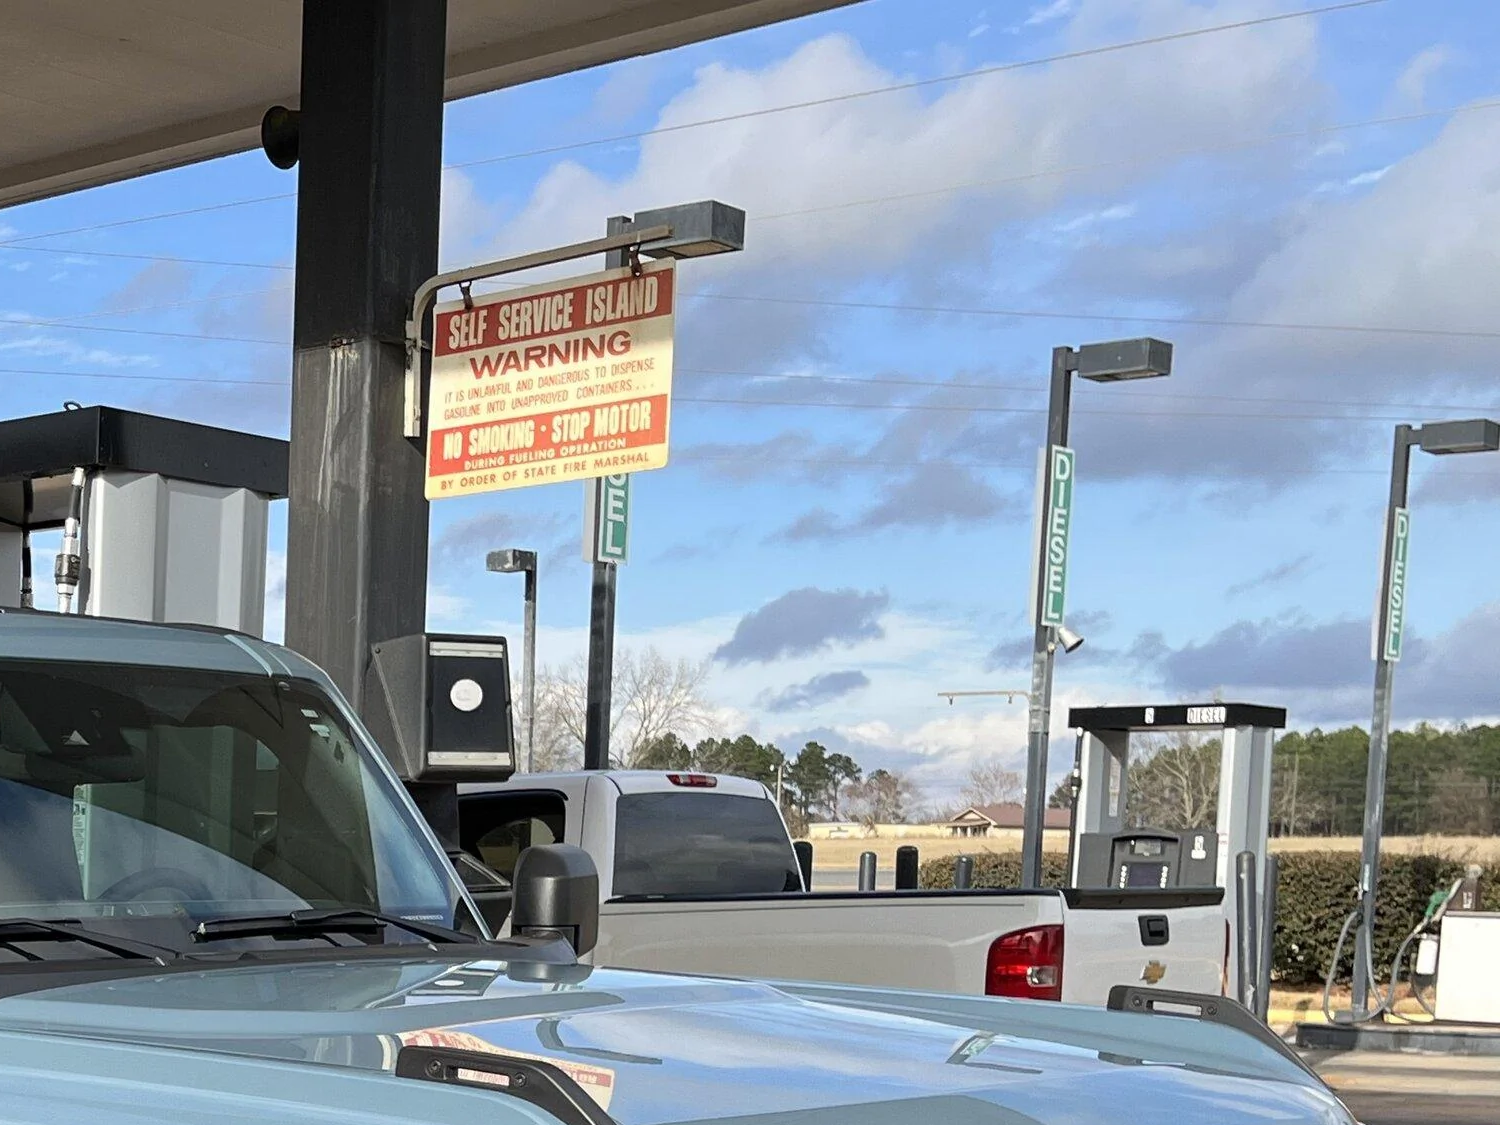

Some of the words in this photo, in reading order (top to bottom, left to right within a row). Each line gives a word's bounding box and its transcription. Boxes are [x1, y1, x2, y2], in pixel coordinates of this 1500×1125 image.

[448, 309, 488, 350] SELF
[497, 292, 575, 340] SERVICE
[585, 276, 659, 324] ISLAND
[469, 330, 632, 379] WARNING
[444, 404, 480, 420] GASOLINE
[487, 400, 506, 413] INTO
[511, 389, 568, 410] UNAPPROVED
[445, 392, 452, 404] IT
[456, 390, 464, 402] IS
[468, 382, 511, 400] UNLAWFUL
[516, 379, 534, 392] AND
[538, 369, 590, 389] DANGEROUS
[595, 366, 606, 378] TO
[611, 358, 655, 376] DISPENSE
[443, 432, 463, 460] NO
[468, 419, 535, 456] SMOKING
[551, 410, 590, 443] STOP
[593, 400, 651, 437] MOTOR
[441, 480, 453, 490] BY
[460, 473, 496, 487] ORDER
[503, 470, 517, 481] OF
[524, 464, 556, 478] STATE
[563, 460, 587, 473] FIRE
[593, 452, 650, 469] MARSHAL
[464, 456, 505, 471] DURING
[509, 447, 555, 464] FUELING
[560, 437, 626, 456] OPERATION
[1046, 452, 1071, 620] DIESEL
[1388, 516, 1408, 655] DIESEL
[1186, 707, 1225, 723] DIESEL
